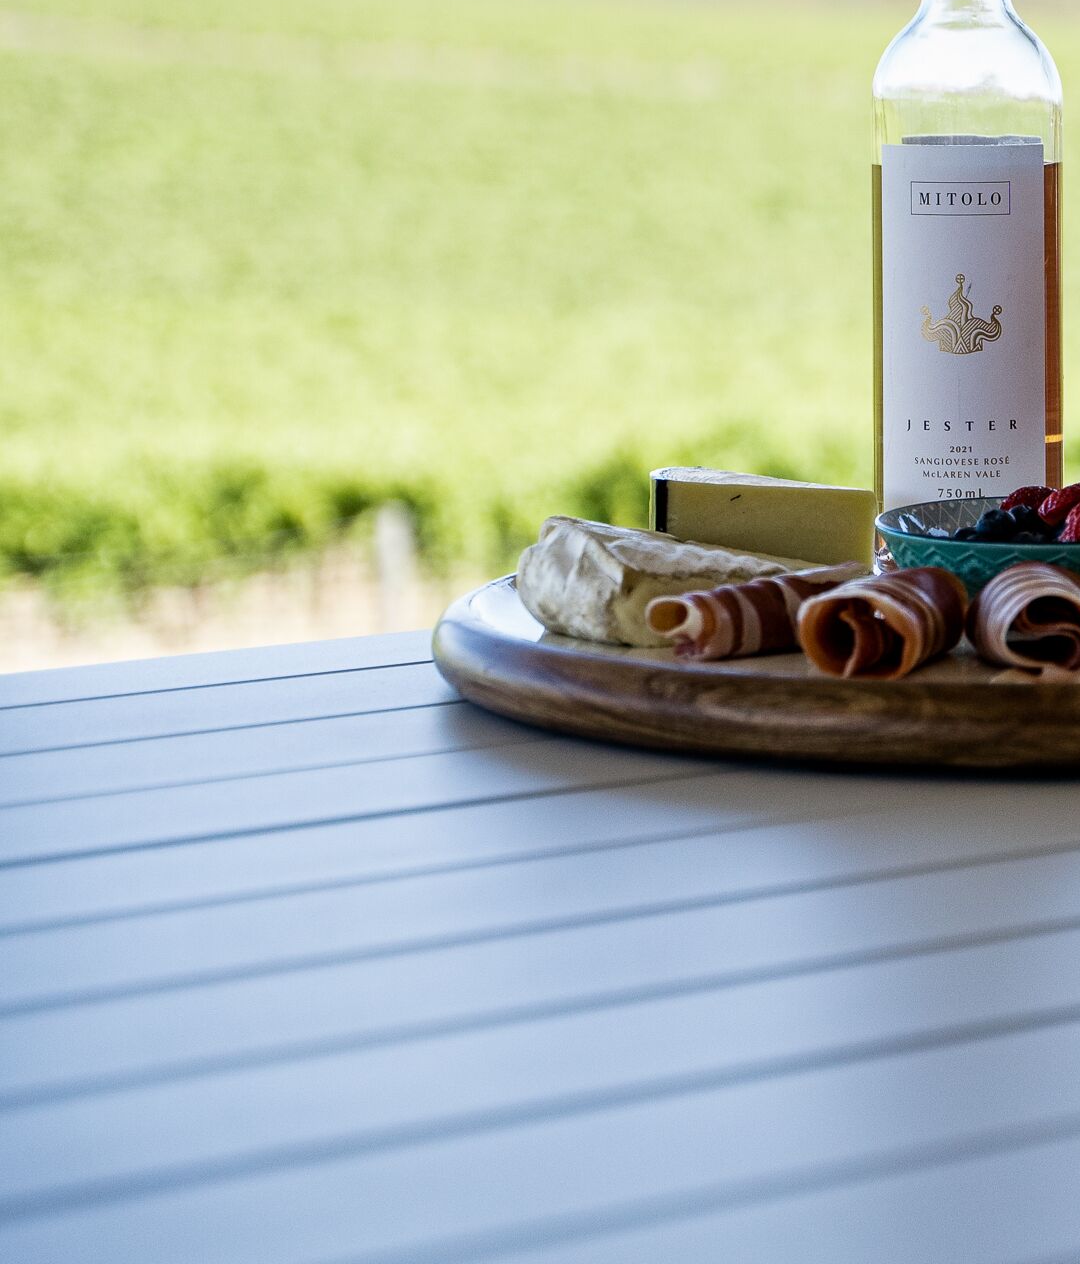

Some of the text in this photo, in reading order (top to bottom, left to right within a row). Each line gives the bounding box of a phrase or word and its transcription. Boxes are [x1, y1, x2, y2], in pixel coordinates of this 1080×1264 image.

[918, 191, 1002, 206] MITOLO
[906, 419, 1018, 432] JESTER
[949, 445, 973, 454] 2021
[914, 455, 1010, 466] SANGIOVESE ROSÉ
[922, 470, 1001, 479] McLAREN VALE
[937, 488, 986, 499] 750mL
